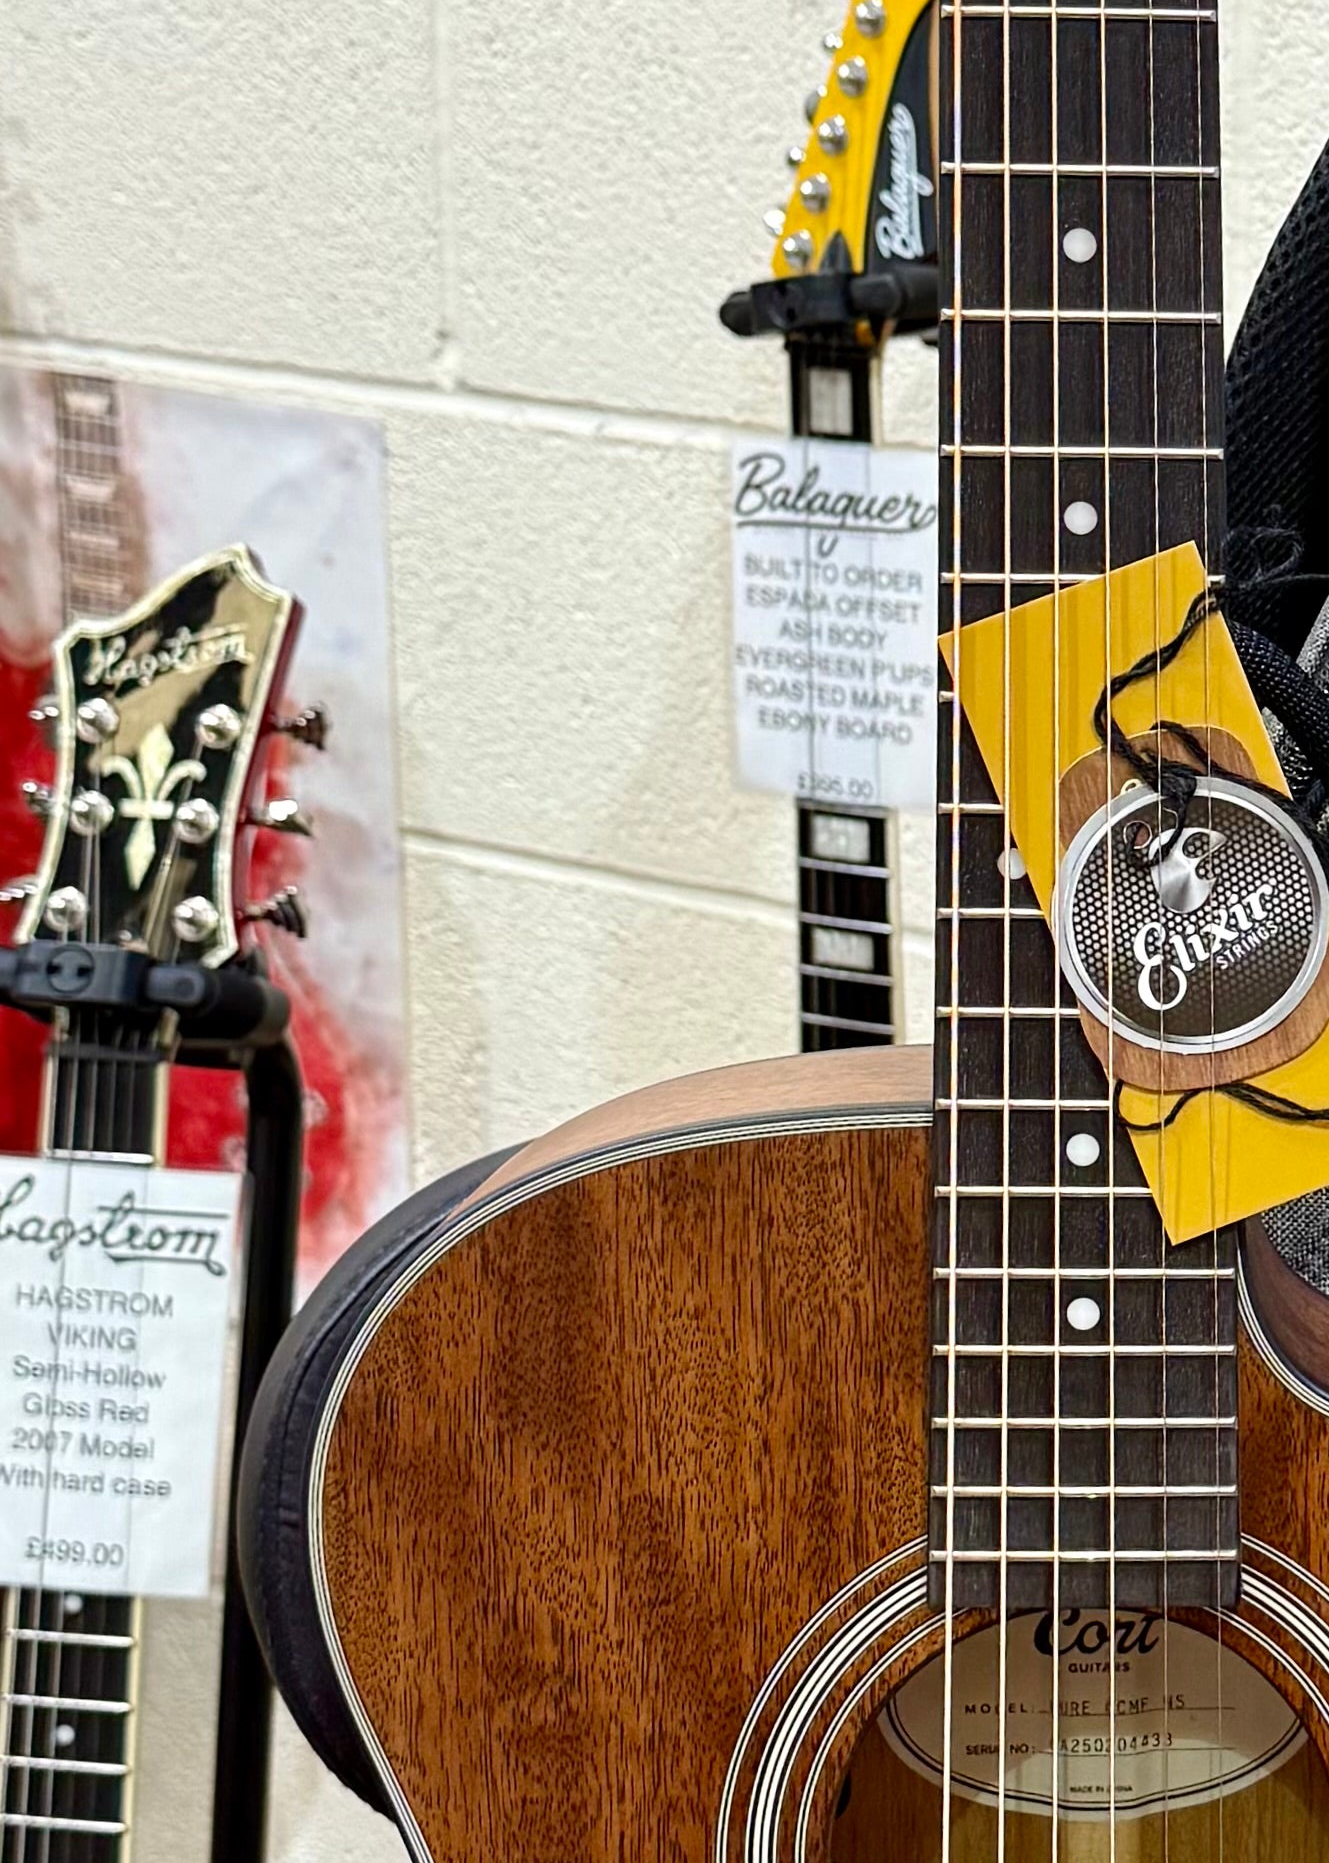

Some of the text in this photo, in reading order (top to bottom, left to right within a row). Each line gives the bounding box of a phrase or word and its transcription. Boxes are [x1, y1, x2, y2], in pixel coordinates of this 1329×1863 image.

[735, 452, 937, 557] Balaguer
[745, 554, 922, 592] BUILT TO ORDER
[835, 594, 920, 623] OFFSET
[780, 619, 887, 651] ASH BODY
[852, 689, 925, 717] MAPLE
[758, 705, 912, 745] EBONY BOARD
[1133, 882, 1274, 1011] Elixir
[1216, 921, 1278, 970] STRINGS
[16, 1282, 174, 1318] HAGSTROM
[47, 1321, 138, 1351] VIKING
[13, 1354, 167, 1388] Semi-Hollow
[23, 1391, 149, 1424] Gloss Red
[12, 1426, 155, 1459] 2007 Model
[53, 1469, 105, 1494] hard
[112, 1476, 172, 1497] case
[25, 1536, 124, 1566] £499.00
[1050, 1700, 1091, 1717] URE
